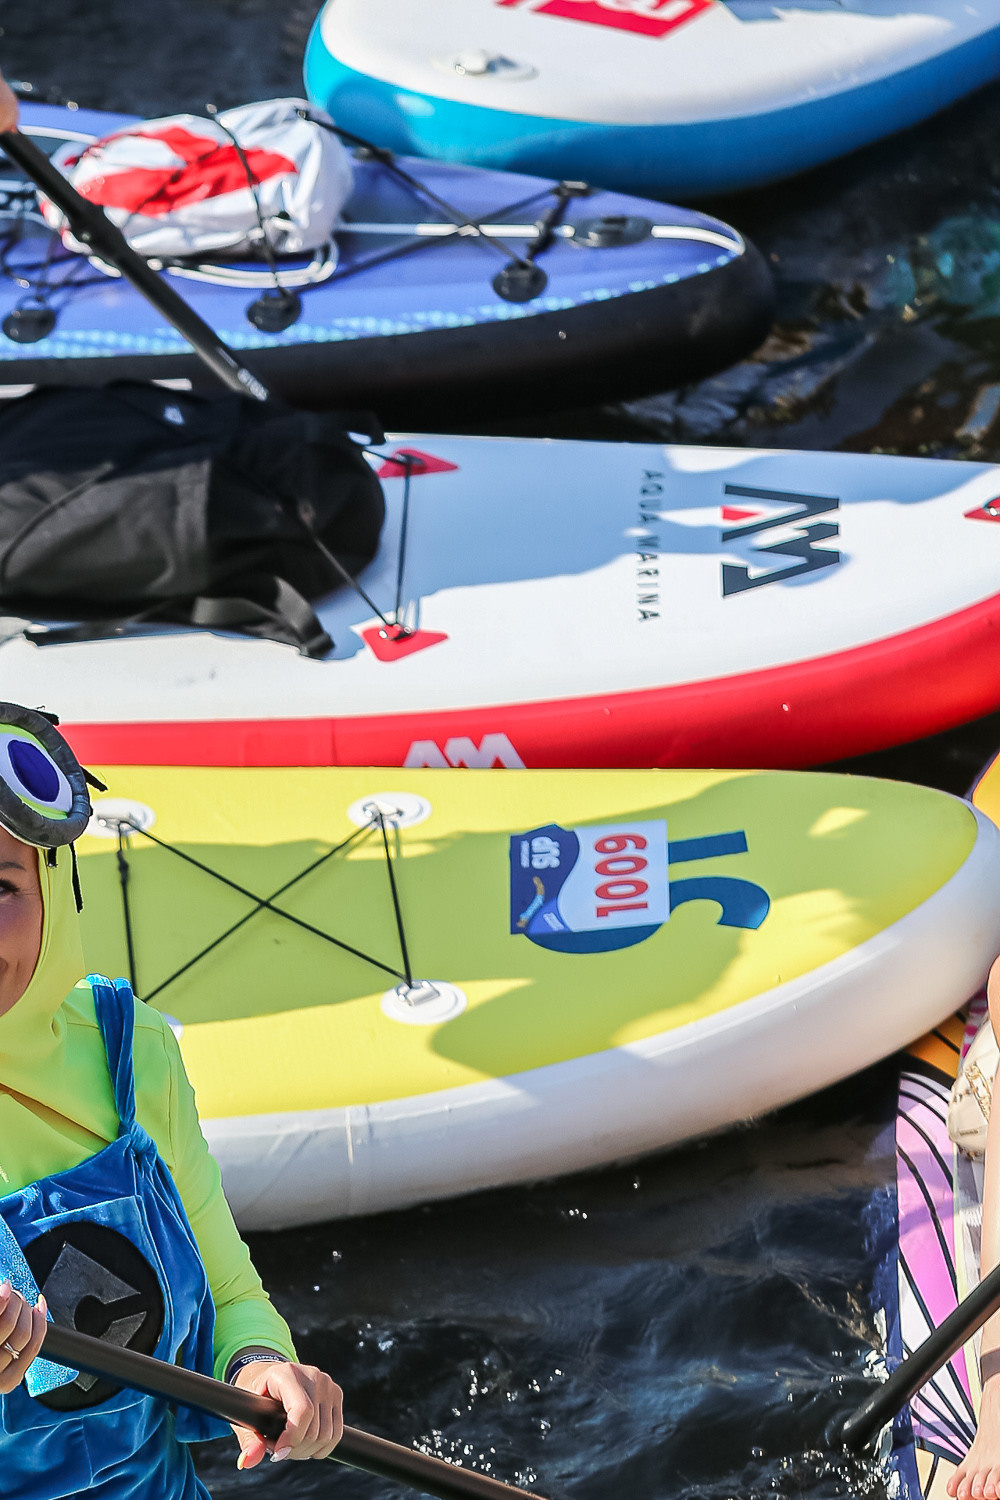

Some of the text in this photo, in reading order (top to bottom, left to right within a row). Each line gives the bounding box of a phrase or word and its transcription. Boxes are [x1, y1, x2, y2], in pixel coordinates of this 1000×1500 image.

[635, 469, 664, 623] AQUA MARINA
[594, 832, 649, 919] 1009
